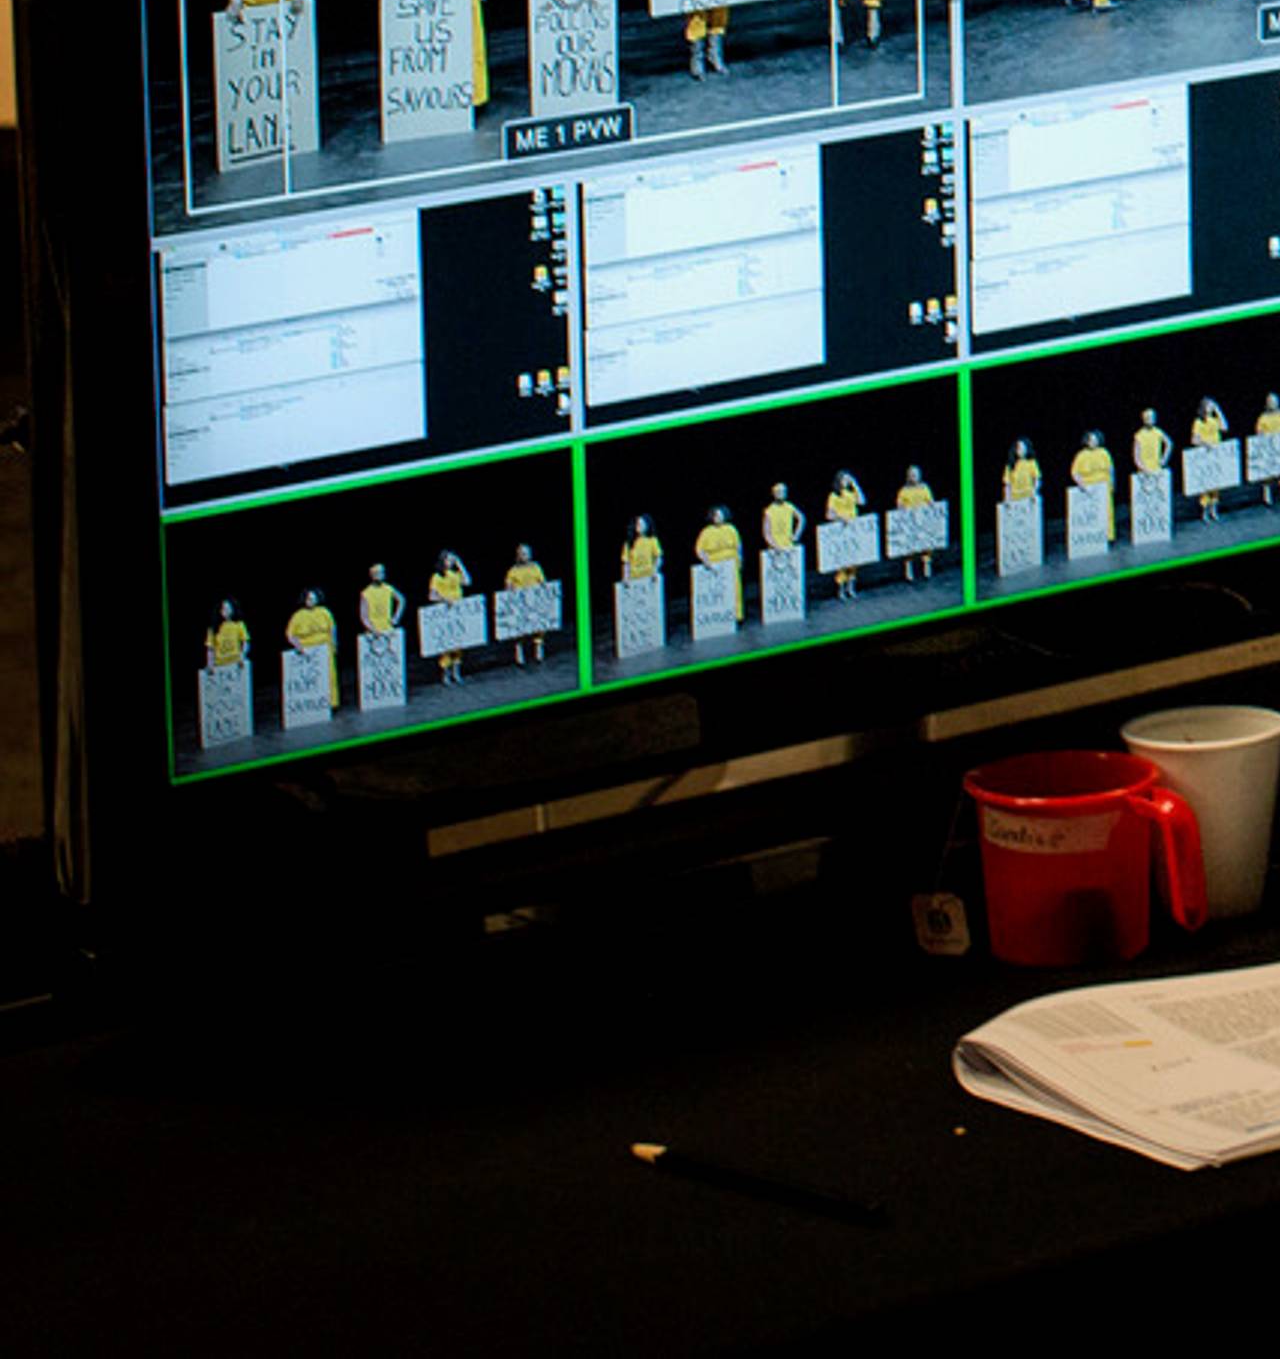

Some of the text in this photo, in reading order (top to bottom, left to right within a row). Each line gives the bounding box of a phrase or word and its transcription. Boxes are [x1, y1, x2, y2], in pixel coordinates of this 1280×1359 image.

[227, 14, 298, 52] STAY
[415, 19, 453, 43] US
[389, 43, 447, 76] FROM
[227, 68, 301, 111] YOUR
[514, 114, 622, 152] ME 1 PVW
